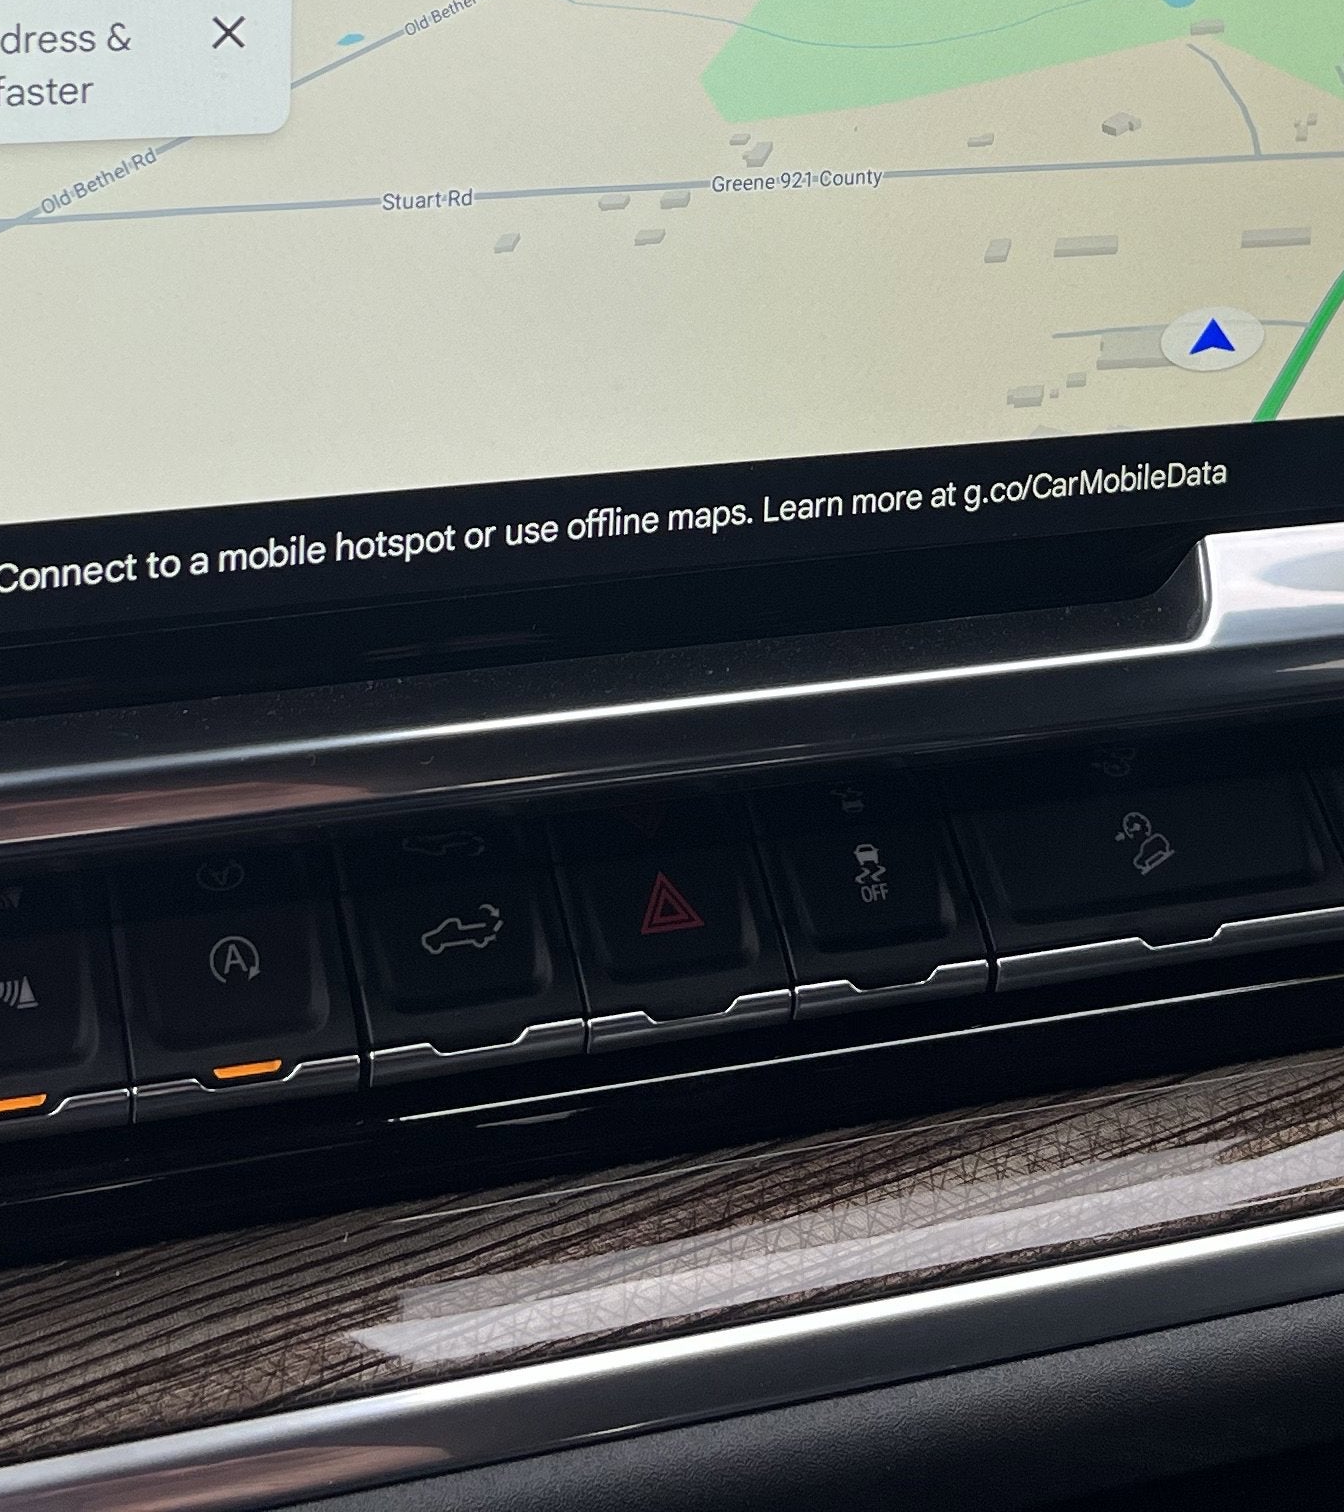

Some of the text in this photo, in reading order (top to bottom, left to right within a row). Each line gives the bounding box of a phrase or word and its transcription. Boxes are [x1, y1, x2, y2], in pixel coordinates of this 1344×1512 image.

[106, 22, 132, 52] &
[404, 14, 430, 36] Old
[41, 147, 157, 214] Old Bethel Rd
[712, 169, 883, 193] Greene 921 County
[382, 187, 473, 211] Stuart Rd
[145, 551, 181, 579] to
[189, 553, 209, 576] a
[217, 535, 327, 573] mobile
[335, 524, 457, 563] hotspot
[464, 523, 496, 550] or
[505, 517, 559, 546] use
[567, 506, 659, 540] offline
[667, 504, 754, 534] maps.
[762, 495, 843, 523] Learn
[852, 488, 923, 515] more
[930, 482, 957, 507] at
[964, 461, 1228, 513] g.co/CarMobileData
[860, 882, 889, 903] OFF
